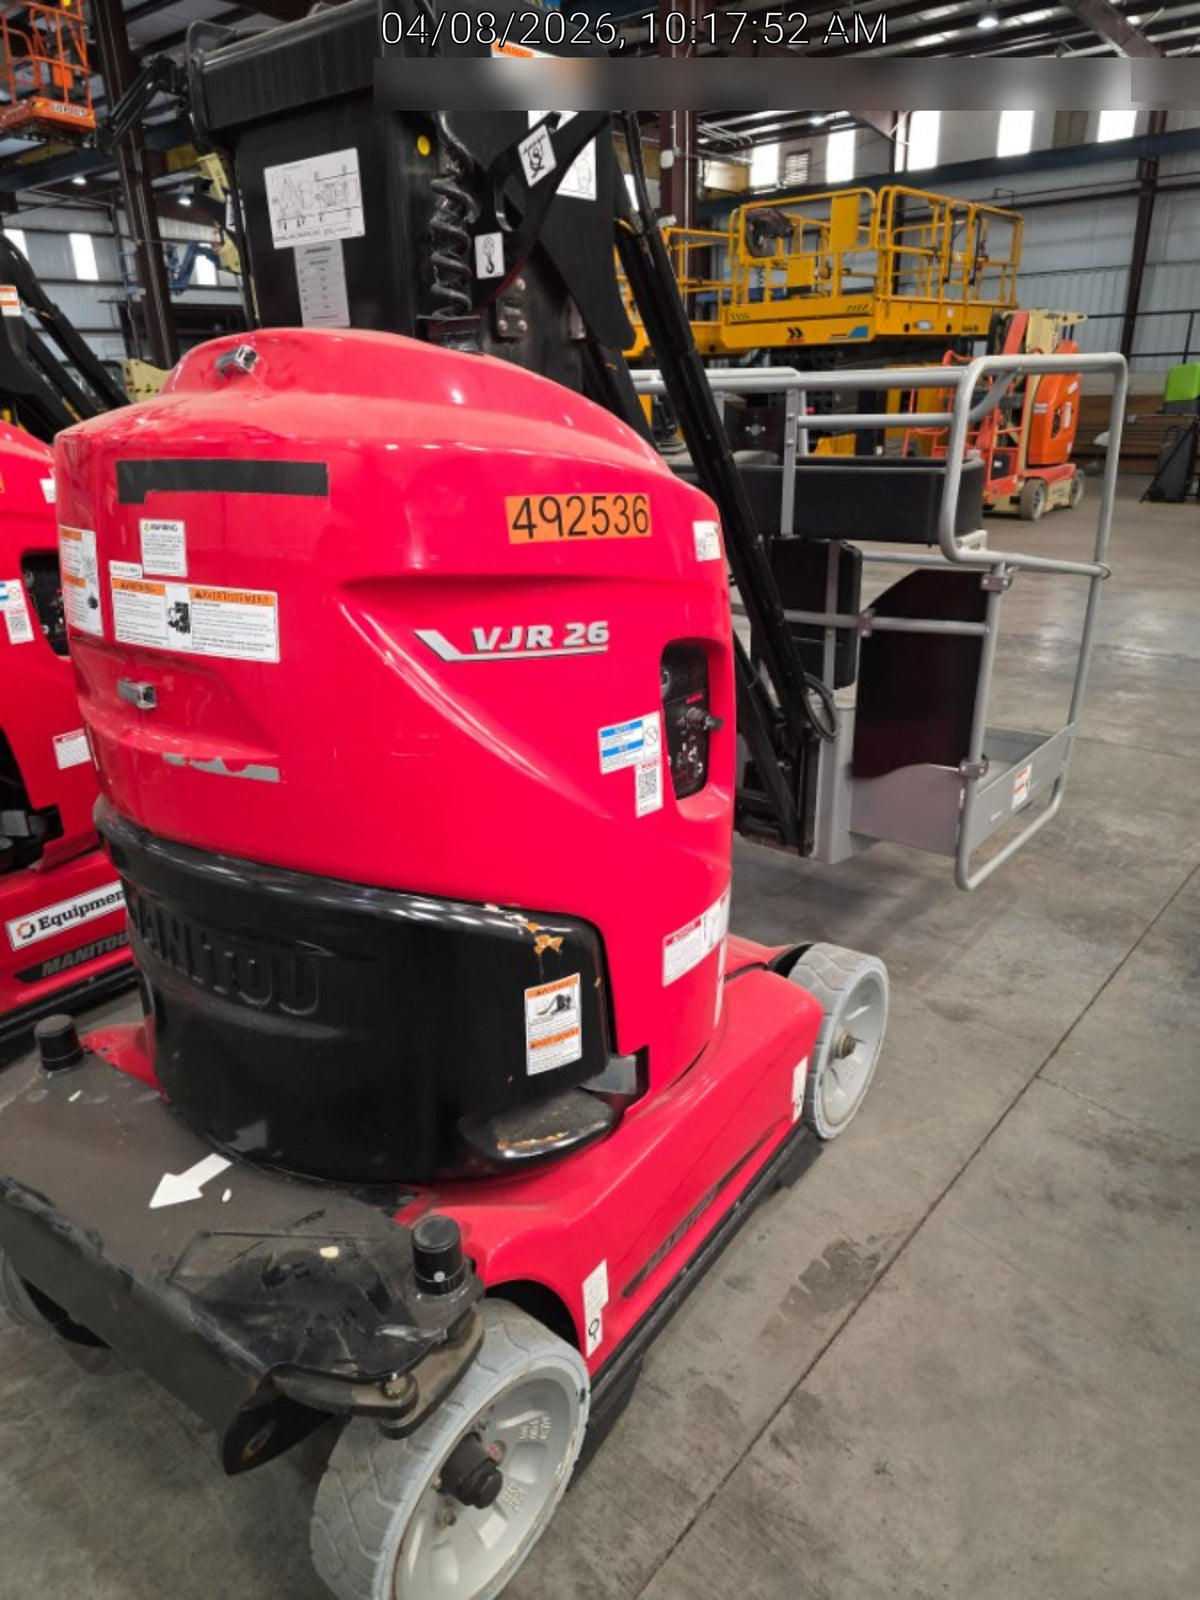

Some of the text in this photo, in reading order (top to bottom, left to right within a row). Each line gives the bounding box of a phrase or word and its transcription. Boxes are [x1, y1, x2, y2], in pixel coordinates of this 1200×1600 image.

[511, 494, 649, 539] 492536
[471, 620, 610, 653] VJR 26
